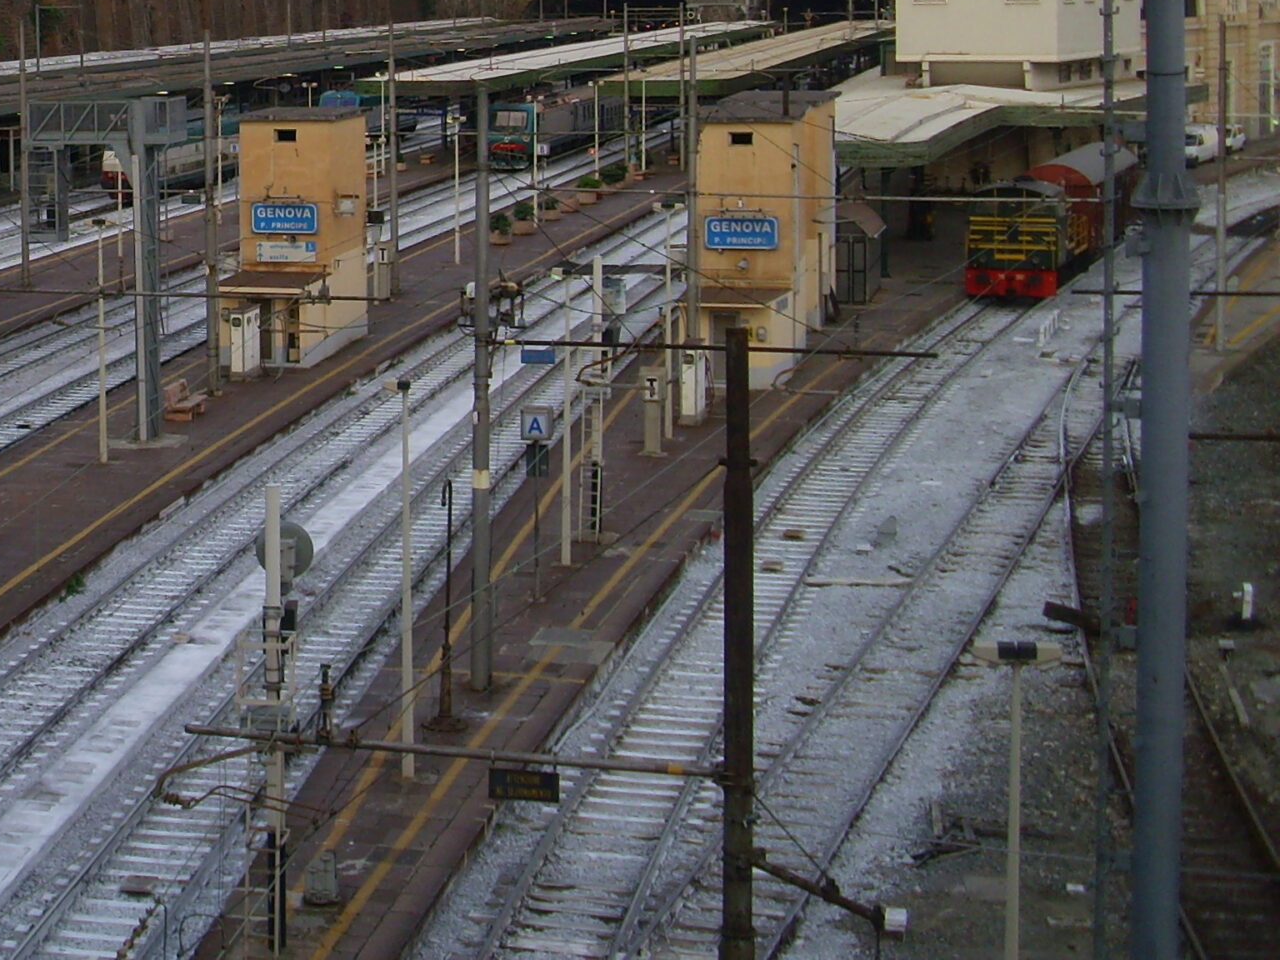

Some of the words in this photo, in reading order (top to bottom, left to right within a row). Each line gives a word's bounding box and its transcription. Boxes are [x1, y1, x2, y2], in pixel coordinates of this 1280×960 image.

[257, 208, 311, 218] GENOVA
[710, 221, 771, 233] GENOVA
[379, 248, 387, 261] T
[646, 378, 657, 398] T
[528, 416, 543, 434] A
